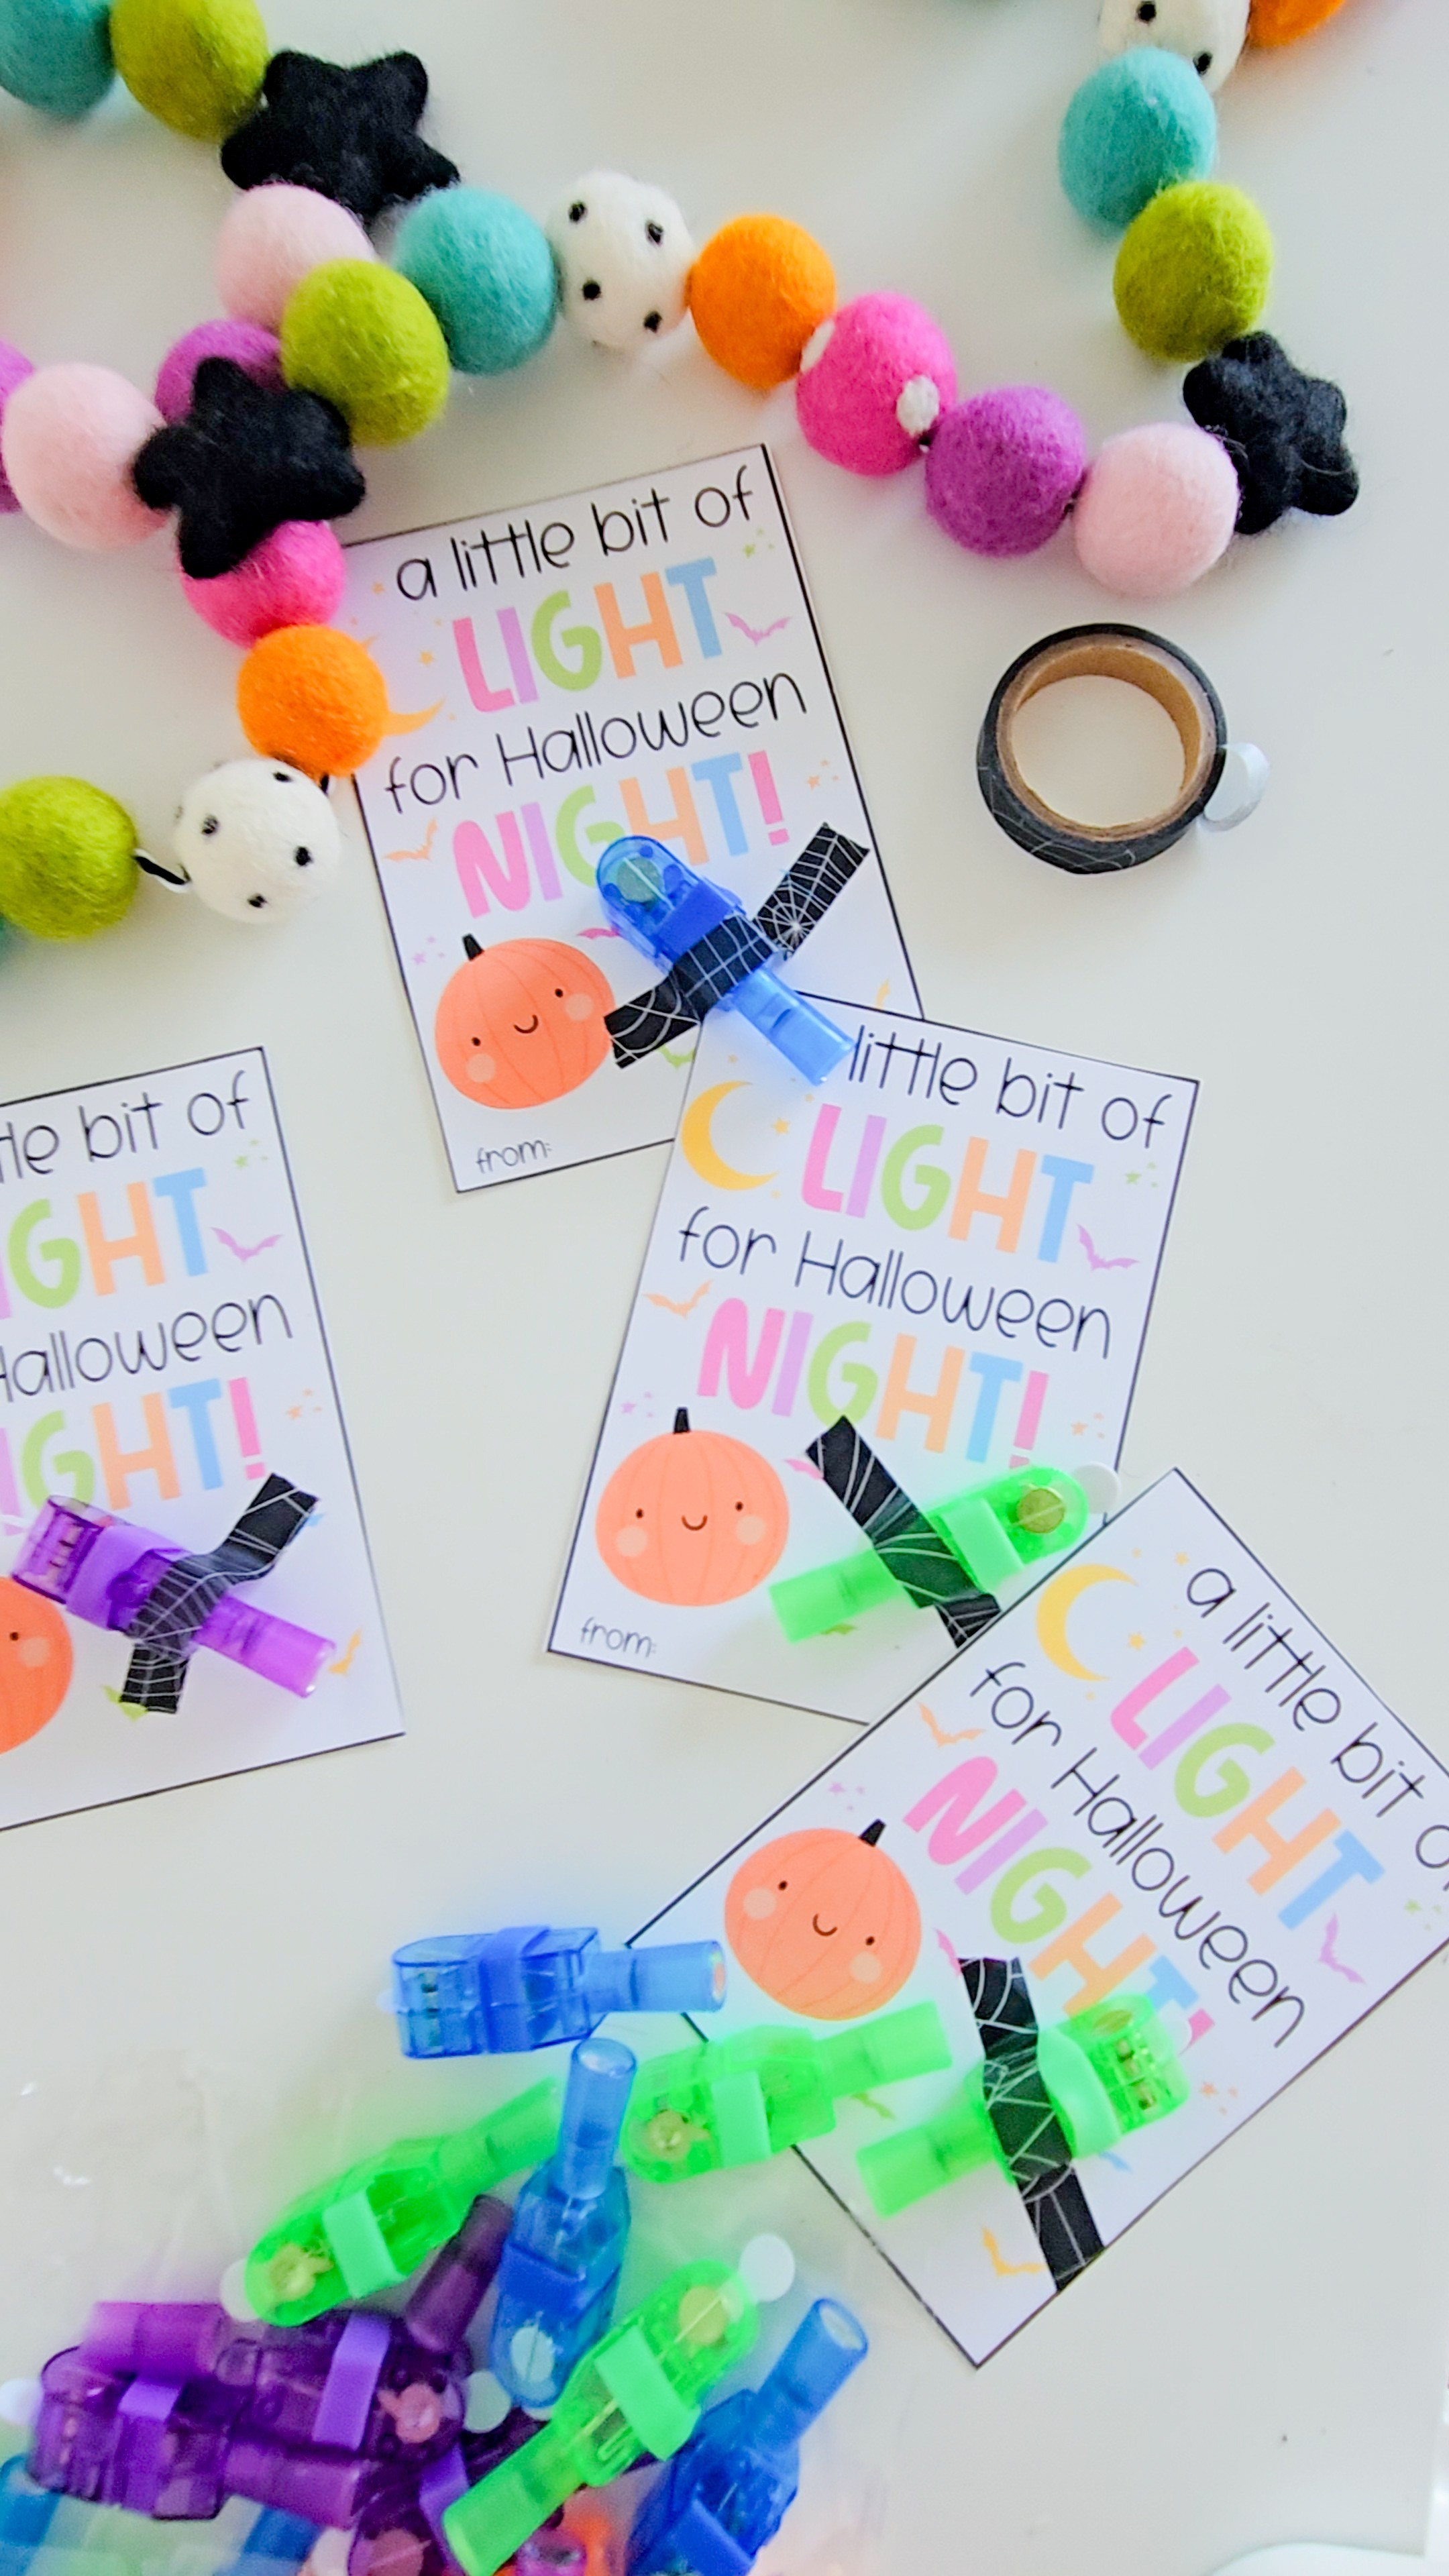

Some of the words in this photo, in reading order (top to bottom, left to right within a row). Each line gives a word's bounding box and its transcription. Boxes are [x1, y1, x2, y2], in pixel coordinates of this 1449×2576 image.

[396, 557, 437, 601] a
[450, 520, 575, 591] little
[591, 488, 670, 557] bit
[694, 465, 753, 528] of
[452, 557, 722, 713] LIGHT
[385, 755, 478, 814] for
[496, 673, 806, 786] Halloween
[452, 751, 790, 918] NIGHT!
[79, 1091, 162, 1161] bit
[188, 1071, 249, 1136] of
[476, 1139, 552, 1174] from:
[849, 1024, 978, 1106] little
[996, 1057, 1085, 1129] bit
[1102, 1094, 1172, 1148] of
[0, 1167, 208, 1320] GHT
[801, 1103, 1095, 1264] LIGHT
[680, 1205, 776, 1274] for
[796, 1231, 1110, 1358] Halloween
[0, 1377, 266, 1532] IGHT!
[696, 1297, 1049, 1469] NIGHT!
[1110, 1646, 1385, 1931] LIGHT
[1187, 1568, 1236, 1617] a
[1222, 1602, 1341, 1731] little
[1330, 1721, 1426, 1817] bit
[1415, 1825, 1449, 1890] o
[970, 1662, 1062, 1746] for
[1051, 1748, 1305, 2048] Halloween
